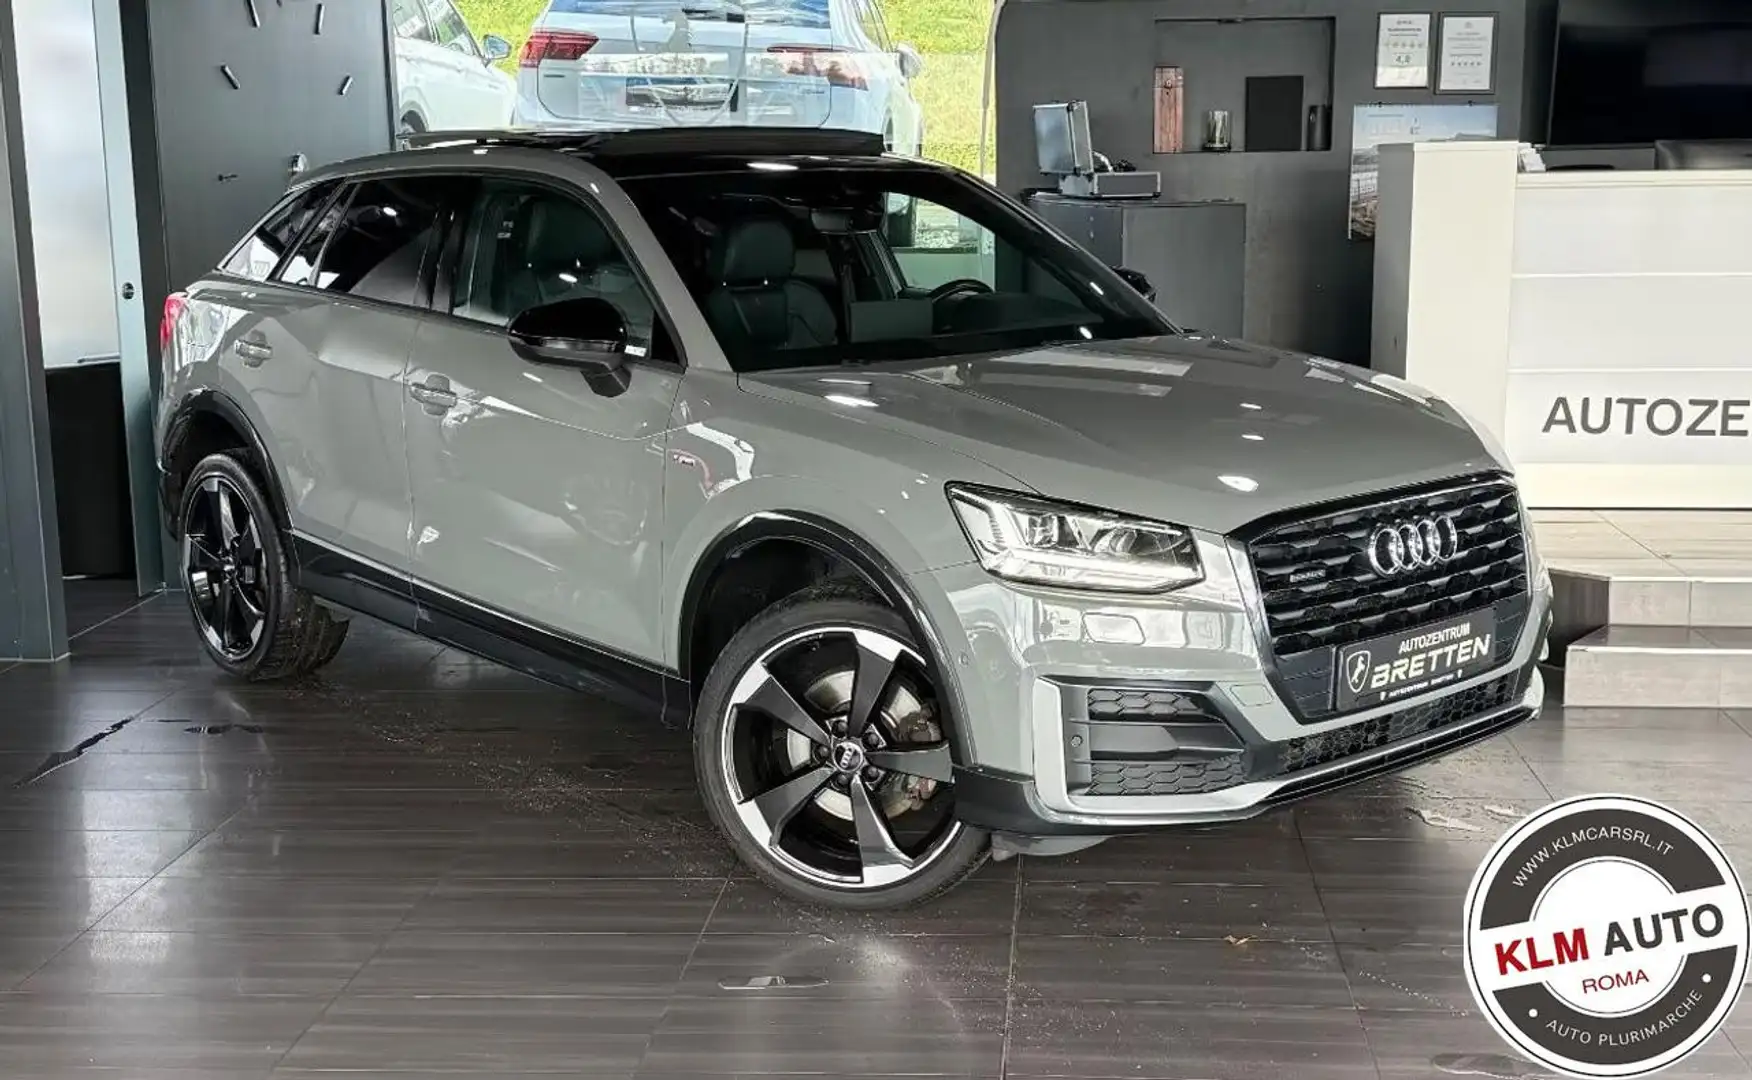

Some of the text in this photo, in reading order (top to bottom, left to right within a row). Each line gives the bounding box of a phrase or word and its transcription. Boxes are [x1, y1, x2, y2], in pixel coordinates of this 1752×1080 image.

[1541, 396, 1751, 437] AUTOZE
[1399, 622, 1471, 655] AUTOZENTRUM
[1370, 633, 1491, 690] BRETTEN
